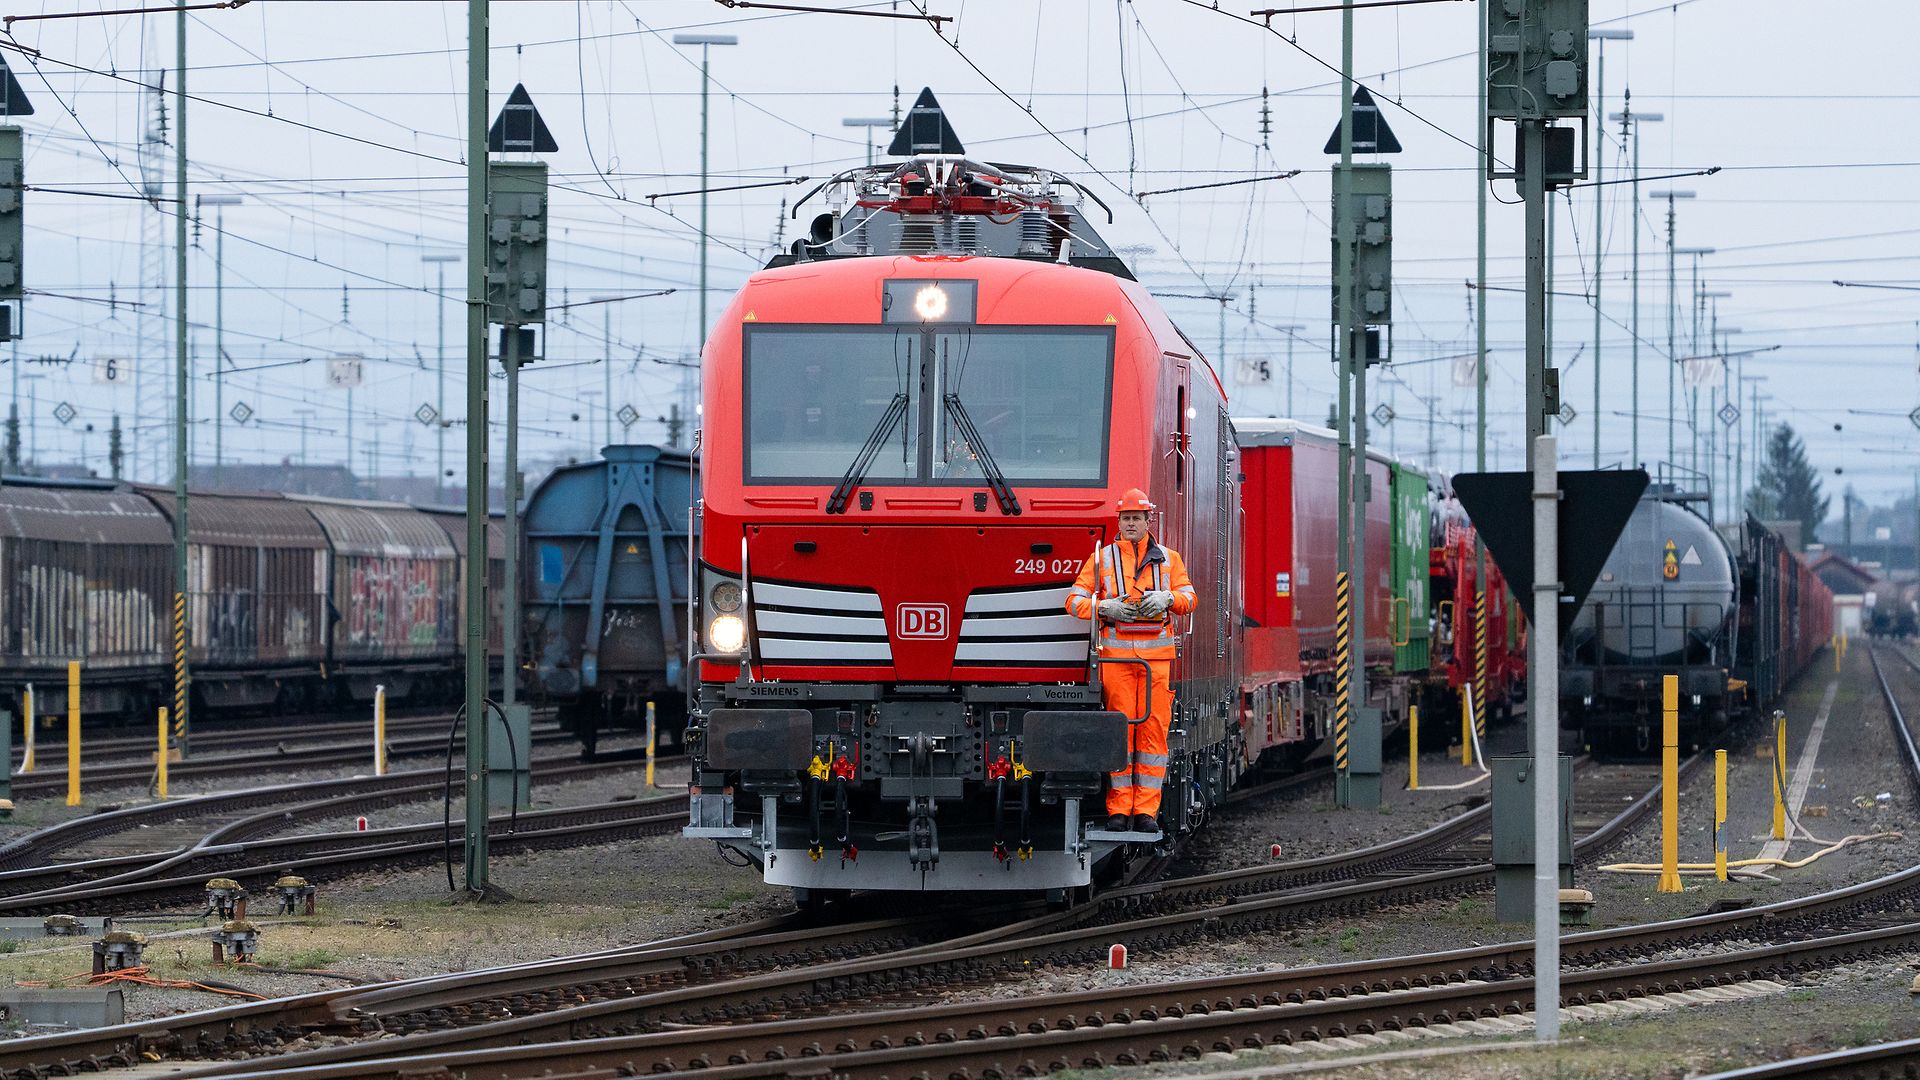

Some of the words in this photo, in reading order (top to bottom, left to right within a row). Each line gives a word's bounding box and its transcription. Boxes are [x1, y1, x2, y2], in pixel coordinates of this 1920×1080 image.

[107, 359, 116, 380] 6
[1260, 361, 1270, 381] 5
[1015, 559, 1046, 574] 249
[1052, 559, 1082, 574] 027
[904, 609, 942, 633] DB
[750, 687, 799, 696] SIEMENS
[1044, 689, 1083, 699] Vectron
